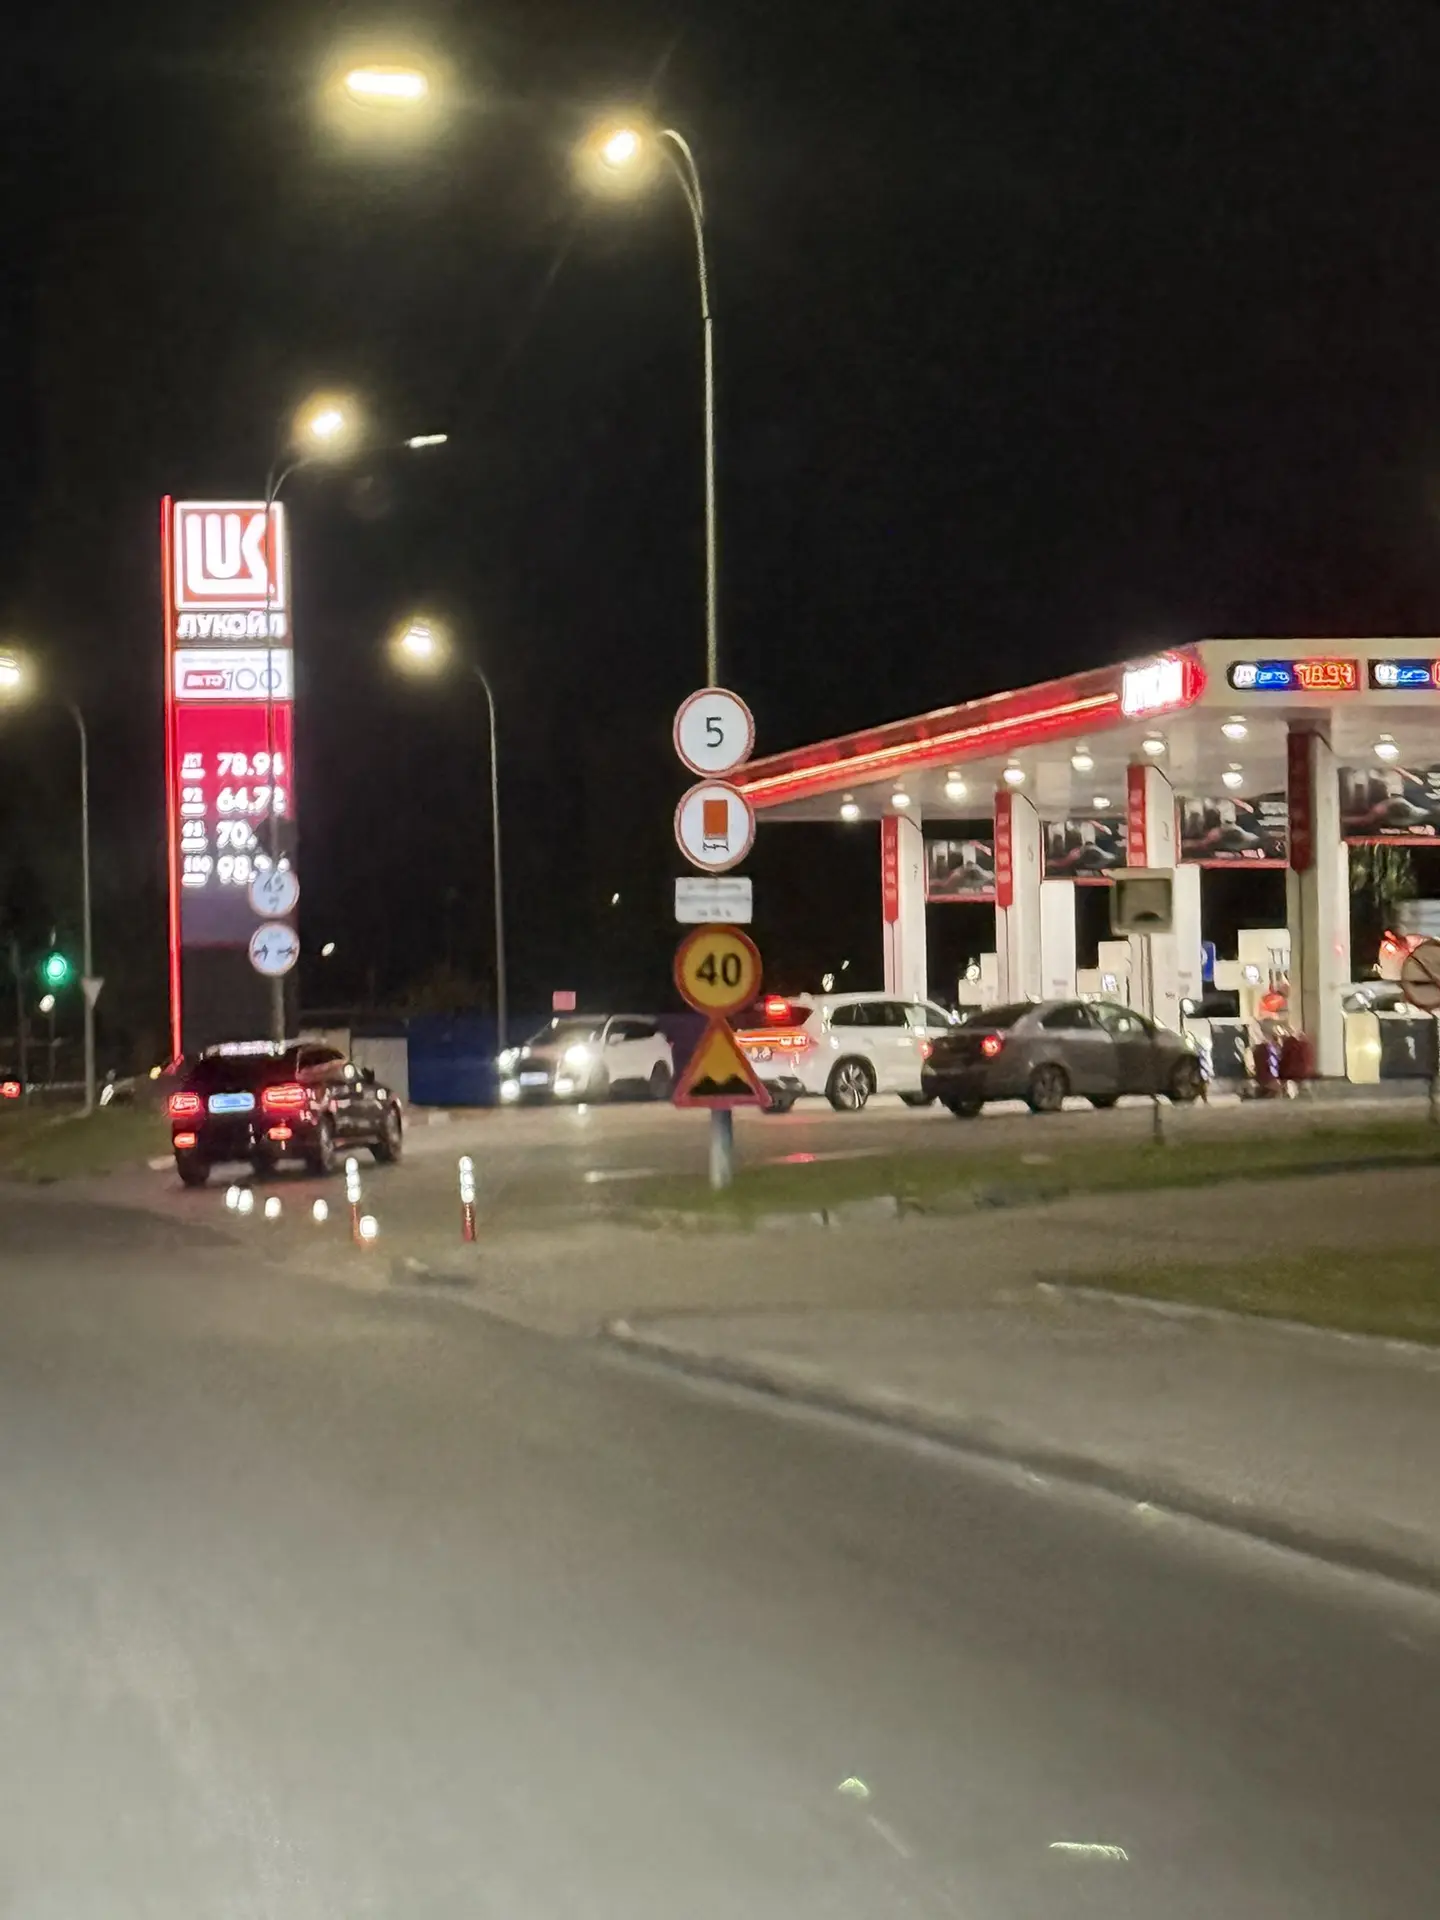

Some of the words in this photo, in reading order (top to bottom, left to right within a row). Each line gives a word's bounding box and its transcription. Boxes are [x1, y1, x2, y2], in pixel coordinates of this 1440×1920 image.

[177, 611, 286, 639] ЛУКОЙЛ
[705, 716, 724, 748] 5
[695, 952, 741, 987] 40
